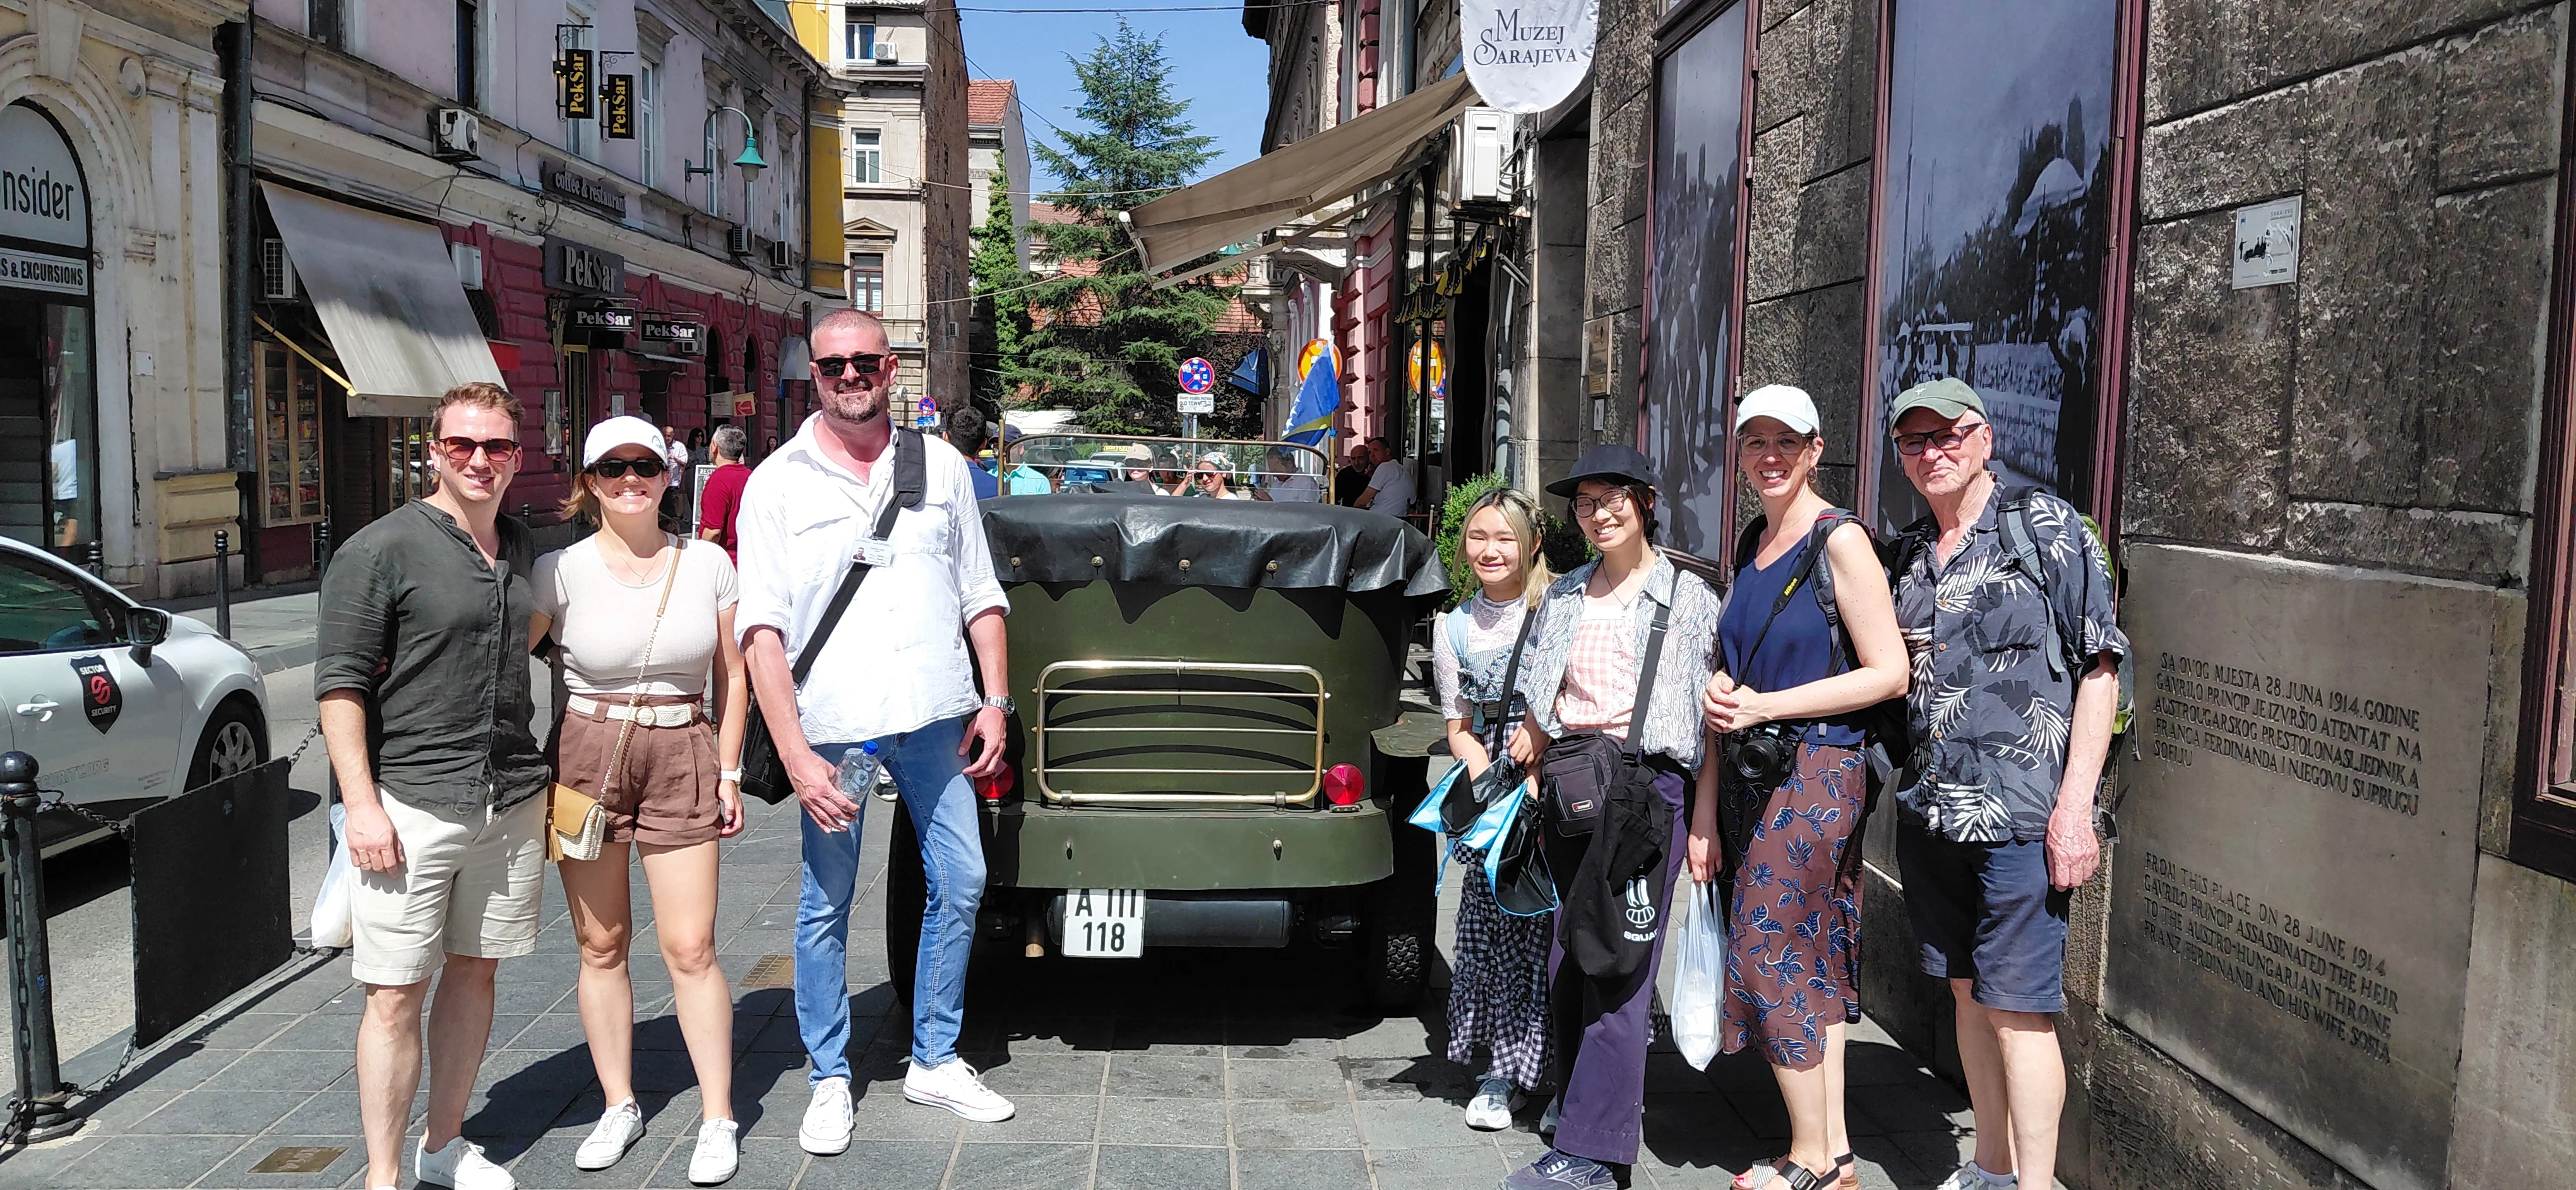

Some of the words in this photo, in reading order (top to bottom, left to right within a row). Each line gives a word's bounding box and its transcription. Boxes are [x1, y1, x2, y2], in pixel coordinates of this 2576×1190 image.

[1494, 8, 1565, 45] MUZEJ
[1474, 27, 1578, 68] SARAJEVA
[569, 52, 584, 114] PekSar
[612, 78, 626, 134] PekSar
[2, 165, 75, 222] nsider
[556, 172, 580, 195] coffee
[589, 185, 626, 212] restaurant
[11, 261, 19, 278] &
[21, 260, 83, 286] EXCURSIONS
[565, 245, 617, 293] PekSar
[576, 310, 632, 326] PekSar
[645, 323, 695, 338] PekSar
[79, 664, 107, 675] SECTOR
[2161, 652, 2175, 672] SA
[2179, 657, 2210, 680] OVOG
[2214, 664, 2260, 693] MJESTA
[91, 704, 117, 717] SECURITY
[2154, 695, 2258, 742] AUSTROUGARSKOG
[2156, 673, 2203, 702] GAVRILO
[2207, 685, 2250, 714] PRINCIP
[2320, 716, 2391, 754] ATENTAT
[2396, 735, 2422, 764] NA
[2154, 739, 2193, 768] SOFIJU
[2154, 717, 2200, 748] FRANCA
[2203, 731, 2277, 774] FERDINANDA
[2288, 757, 2349, 793] NJEGOVU
[2351, 778, 2419, 818] SUPRUGU
[1075, 888, 1093, 917] A
[2144, 851, 2176, 882] FROM
[2181, 867, 2208, 897] THIS
[2211, 882, 2251, 916] PLACE
[2258, 903, 2278, 928] ON
[2284, 914, 2301, 938] 28
[2306, 925, 2346, 960] JUNE
[1082, 922, 1125, 953] 118
[2144, 874, 2188, 910] GAVRILO
[2190, 895, 2233, 932] PRINCIP
[2234, 918, 2327, 977] ASSASSINATED
[2329, 961, 2358, 994] THE
[2361, 976, 2399, 1014] HEIR
[2144, 896, 2159, 920] TO
[2161, 906, 2183, 932] THE
[2185, 918, 2322, 1003] AUSTRO-HUNGARIAN
[2325, 986, 2392, 1039] THRONE
[2144, 920, 2182, 954] FRANZ
[2184, 940, 2253, 992] FERDINAND
[2255, 978, 2286, 1009] AND
[2287, 993, 2310, 1023] HIS
[2312, 1005, 2347, 1041] WIFE
